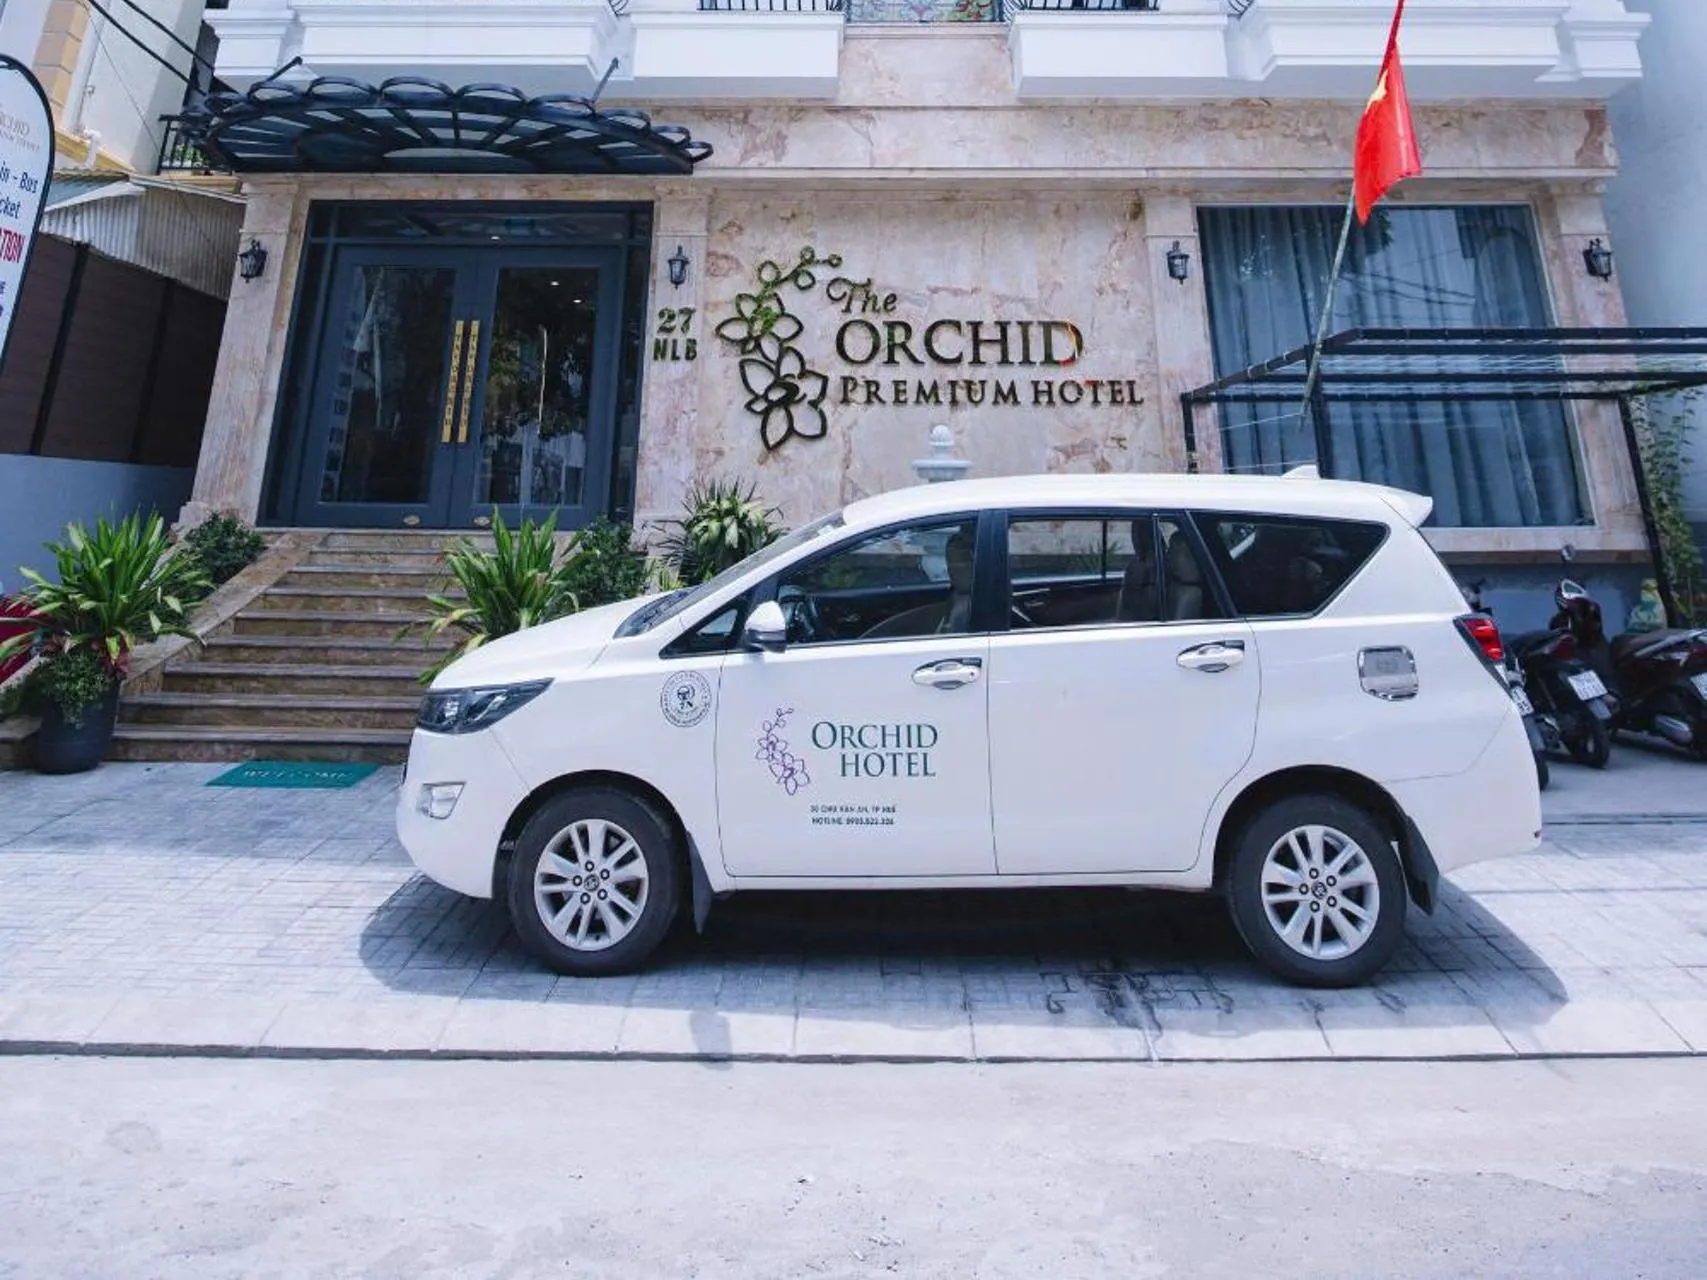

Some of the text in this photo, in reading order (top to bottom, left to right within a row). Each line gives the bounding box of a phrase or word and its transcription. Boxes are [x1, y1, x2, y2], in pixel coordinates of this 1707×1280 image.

[826, 276, 898, 313] The
[657, 306, 697, 334] 27
[653, 338, 698, 361] NLB
[835, 319, 1084, 365] ORCHID
[840, 376, 1144, 405] PREMIUM HOTEL
[812, 721, 938, 750] ORCHID
[840, 752, 936, 778] HOTEL
